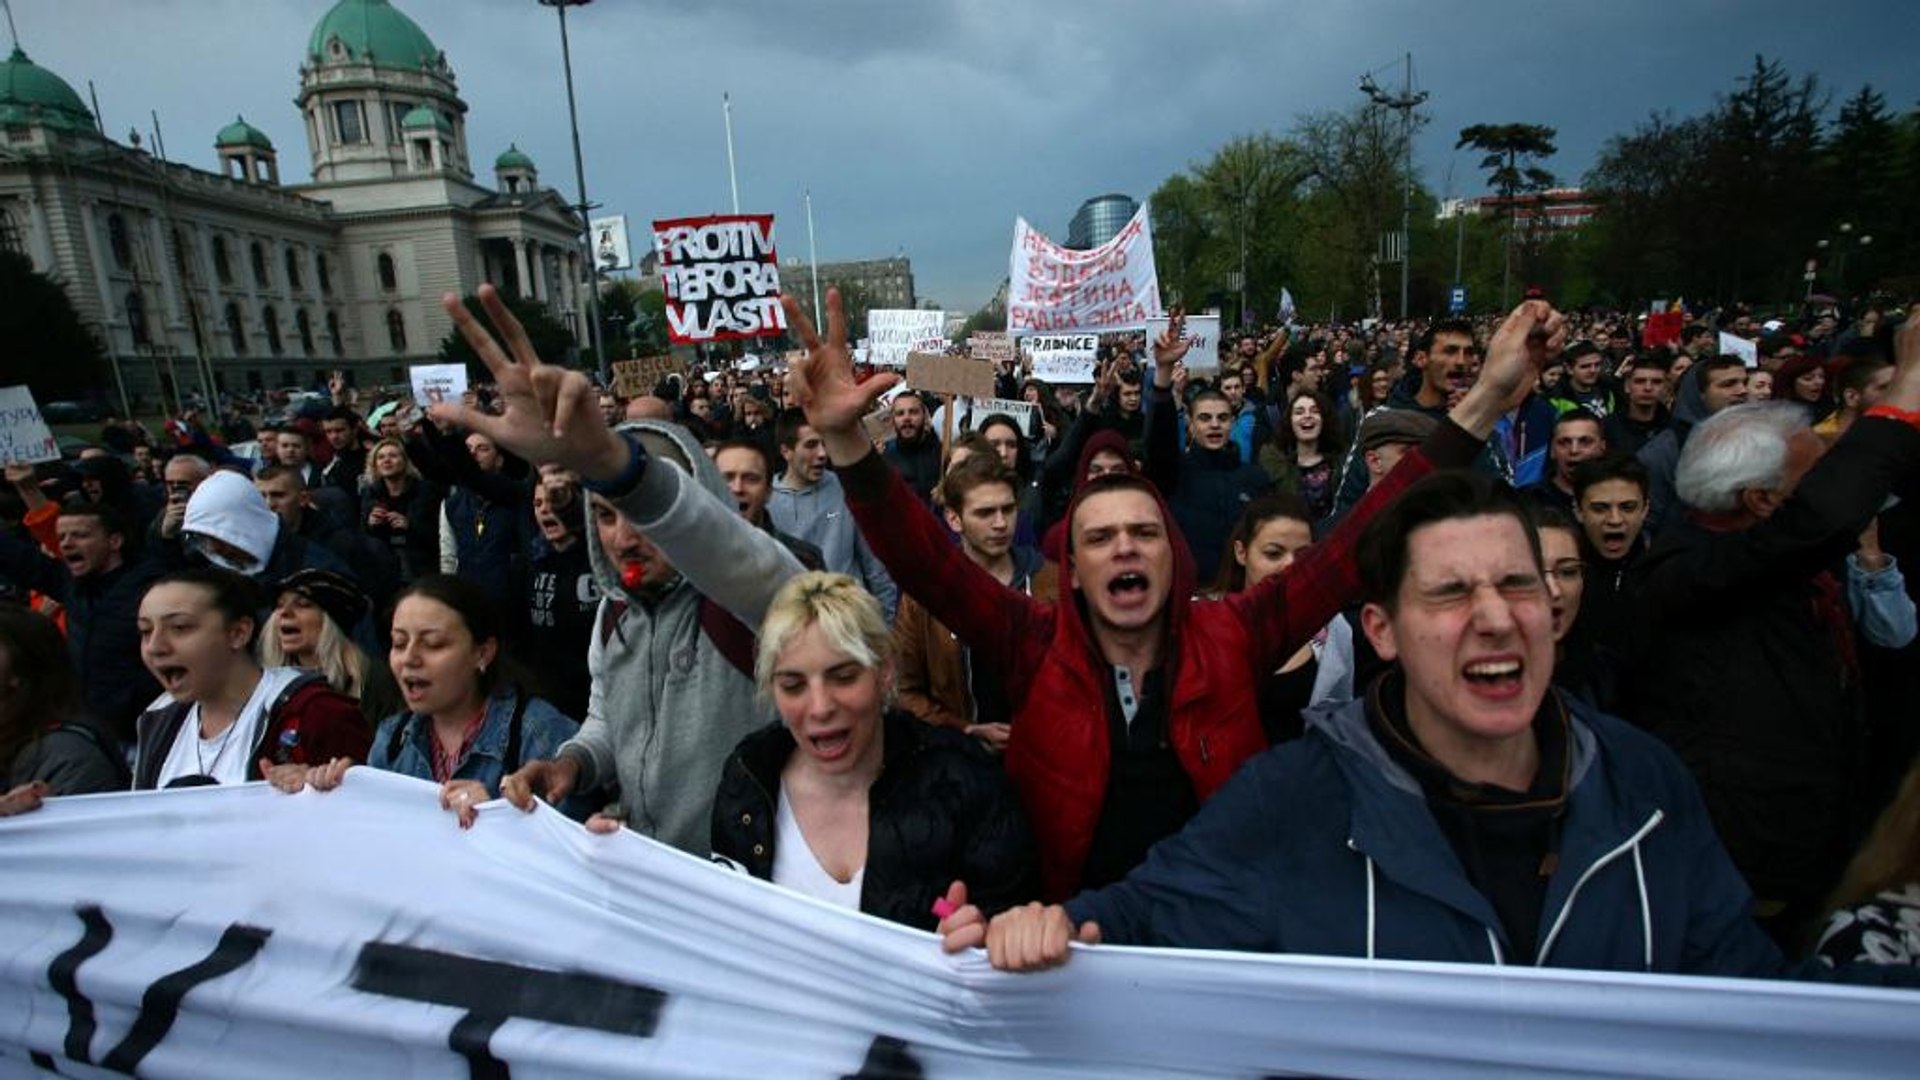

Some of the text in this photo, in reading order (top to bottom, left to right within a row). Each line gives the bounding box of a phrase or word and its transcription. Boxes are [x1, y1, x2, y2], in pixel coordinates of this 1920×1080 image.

[655, 221, 775, 264] PROTIV
[661, 260, 780, 301] TERORA
[666, 296, 787, 338] VLASTI
[1011, 306, 1079, 331] РАДНА
[1033, 337, 1094, 352] RADNICE
